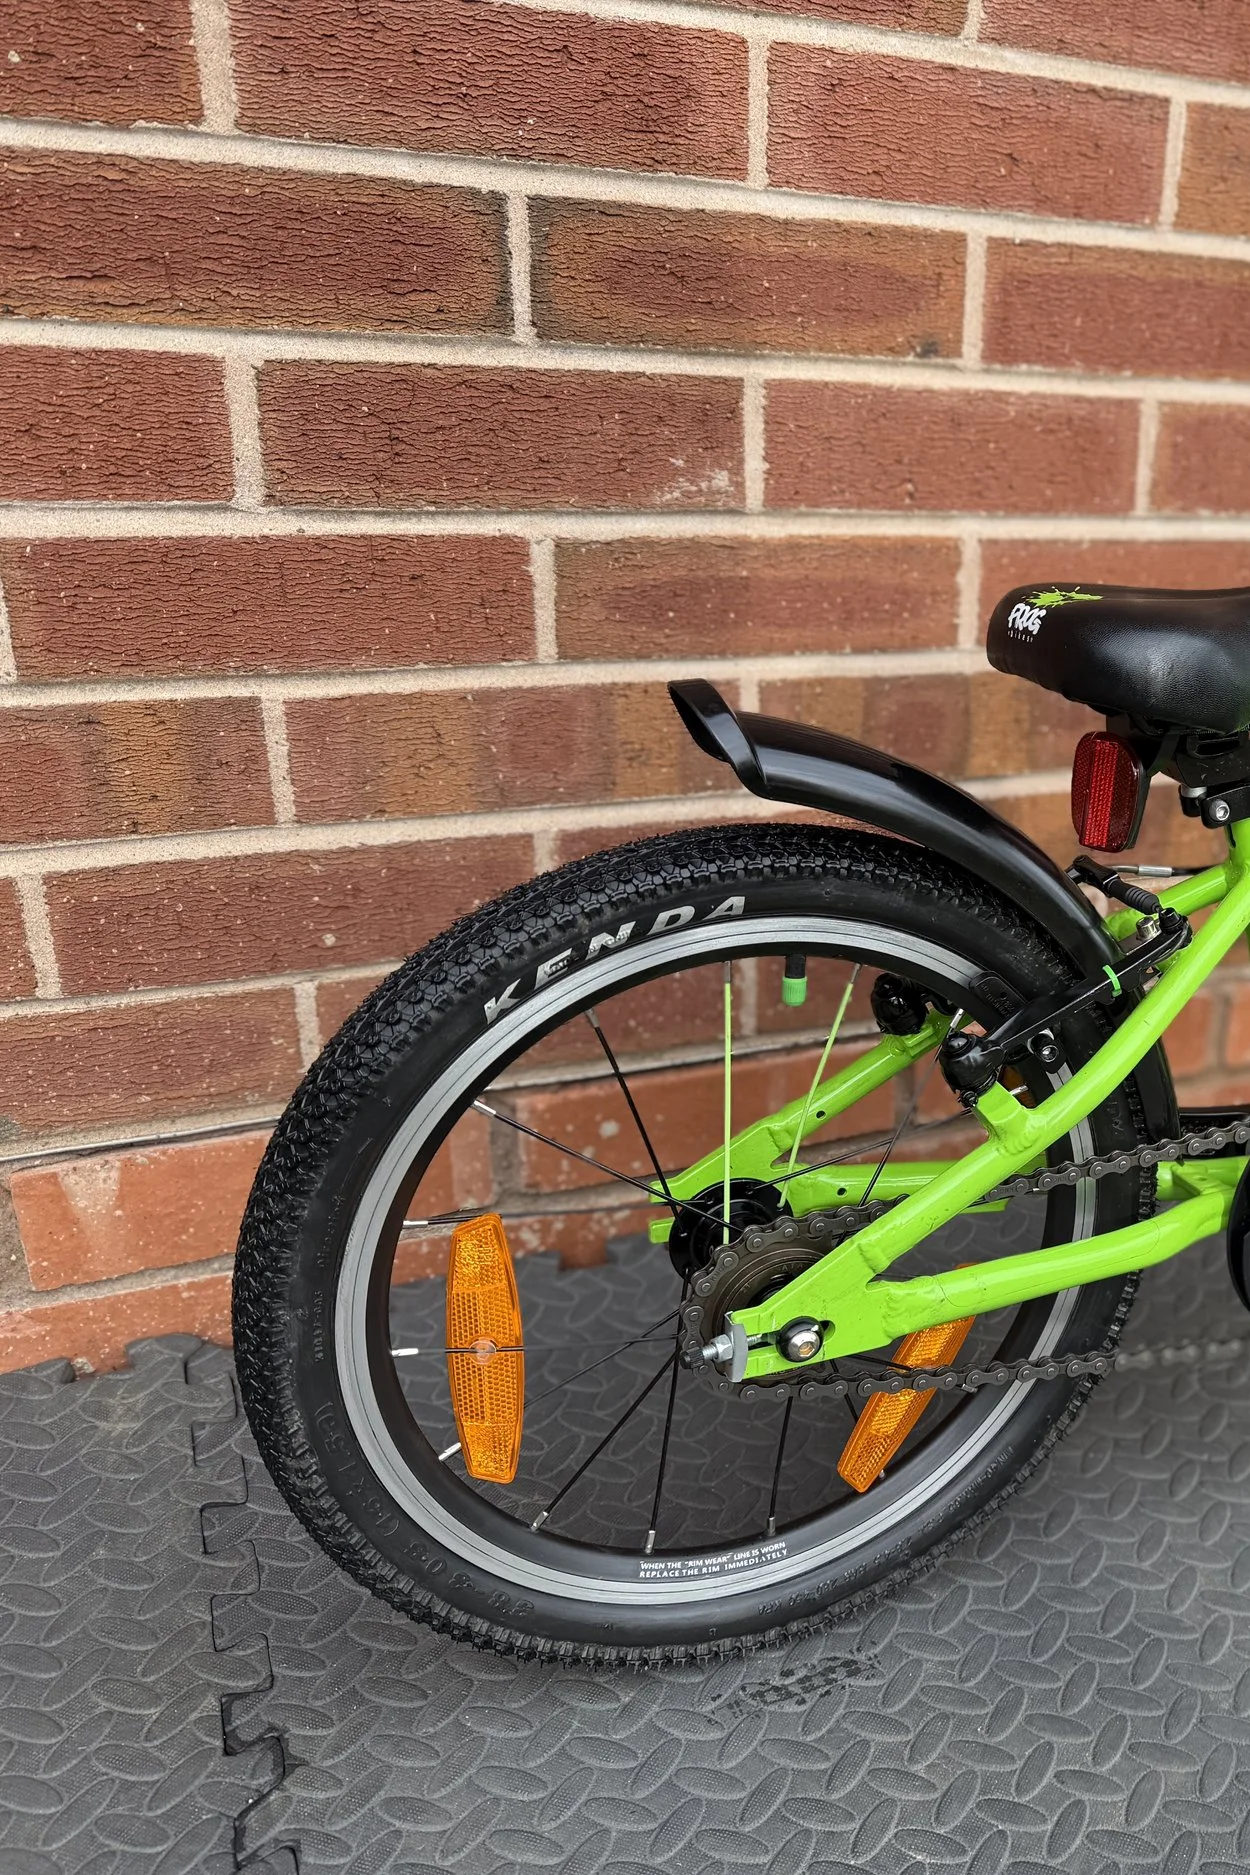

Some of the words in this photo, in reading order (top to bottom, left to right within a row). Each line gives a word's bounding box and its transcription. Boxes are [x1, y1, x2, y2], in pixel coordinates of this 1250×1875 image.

[1007, 602, 1047, 635] FROG
[483, 896, 746, 1025] KENDA
[640, 1570, 680, 1578] REPLACE
[682, 1568, 699, 1576] THE
[702, 1565, 720, 1574] RIM
[724, 1549, 787, 1571] IMMEDIATELY
[734, 1551, 751, 1560] LINE
[752, 1549, 760, 1557] IS
[761, 1541, 786, 1554] WORN
